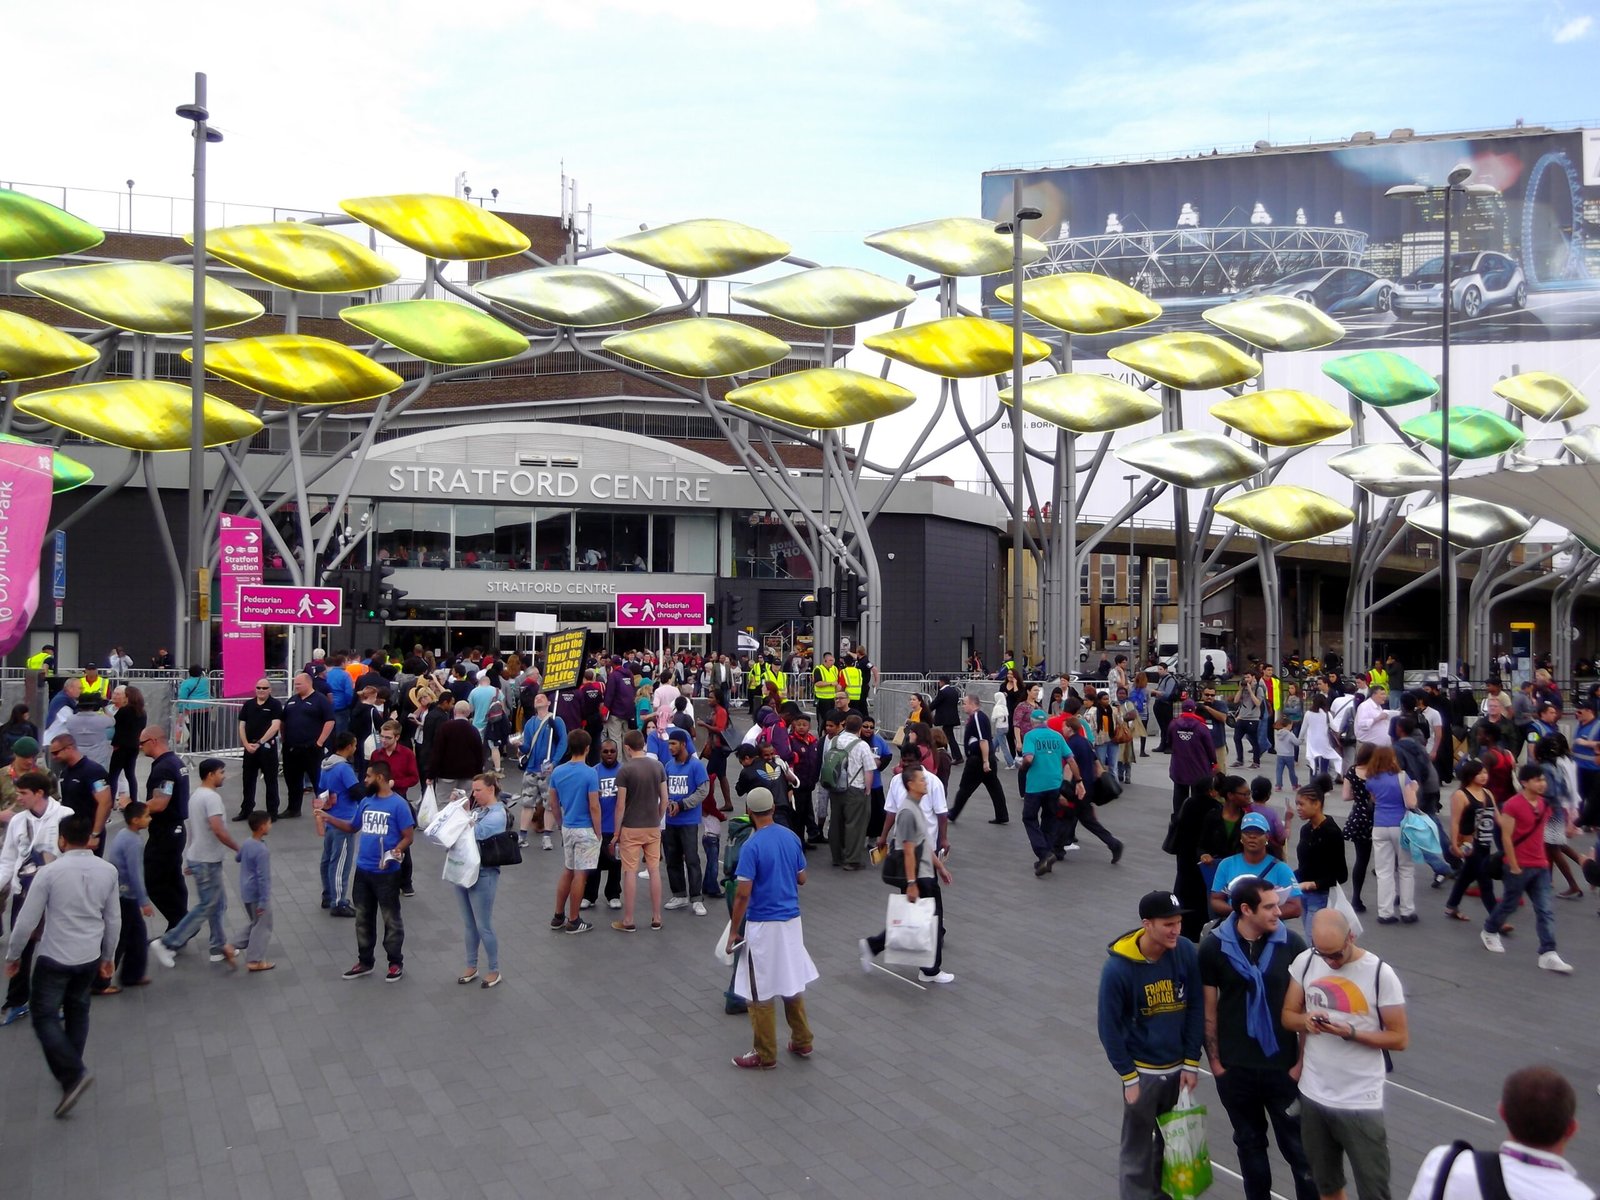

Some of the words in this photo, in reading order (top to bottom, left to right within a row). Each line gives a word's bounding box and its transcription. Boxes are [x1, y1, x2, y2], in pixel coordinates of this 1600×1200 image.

[1031, 421, 1055, 429] BORN
[389, 465, 579, 497] STRATFORD
[590, 473, 711, 502] CENTRE
[487, 581, 563, 593] STRATFORD
[566, 582, 616, 594] CENTRE
[243, 595, 282, 604] Pedestrian
[656, 601, 690, 609] Pedestrian
[243, 607, 273, 615] through
[657, 612, 682, 620] through
[554, 641, 570, 652] am
[571, 639, 583, 648] the
[569, 649, 582, 659] the
[546, 660, 573, 674] Truth
[1036, 739, 1060, 751] DRUGS
[668, 776, 689, 786] TEAM
[362, 811, 390, 824] TEAM
